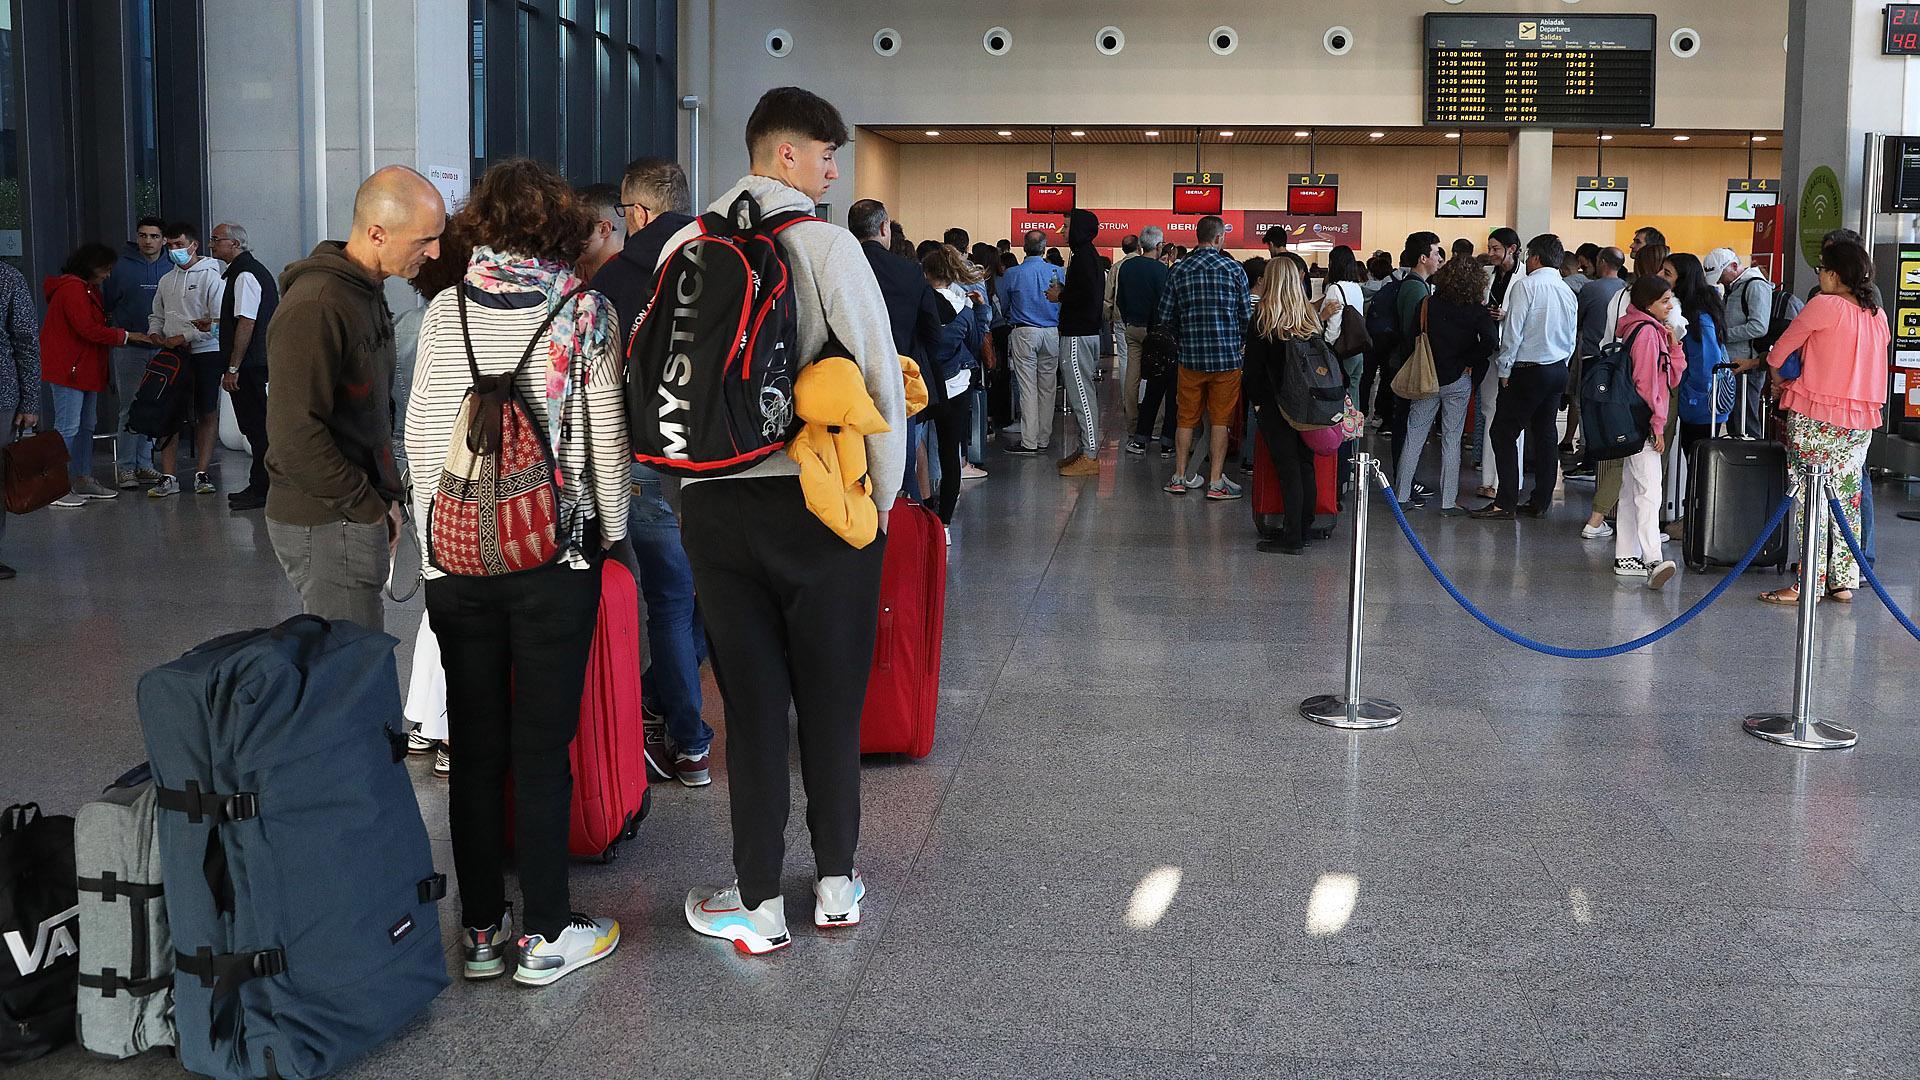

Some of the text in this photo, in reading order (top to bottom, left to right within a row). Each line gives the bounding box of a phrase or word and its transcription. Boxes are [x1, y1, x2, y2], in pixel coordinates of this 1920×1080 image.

[1055, 172, 1063, 183] 9
[1202, 173, 1211, 184] 8
[1317, 174, 1326, 185] 7
[1467, 176, 1475, 187] 6
[1607, 178, 1615, 188] 5
[1758, 179, 1767, 190] 4
[1020, 222, 1056, 230] IBERIA
[1322, 225, 1341, 233] Priority
[1908, 317, 1917, 325] kg
